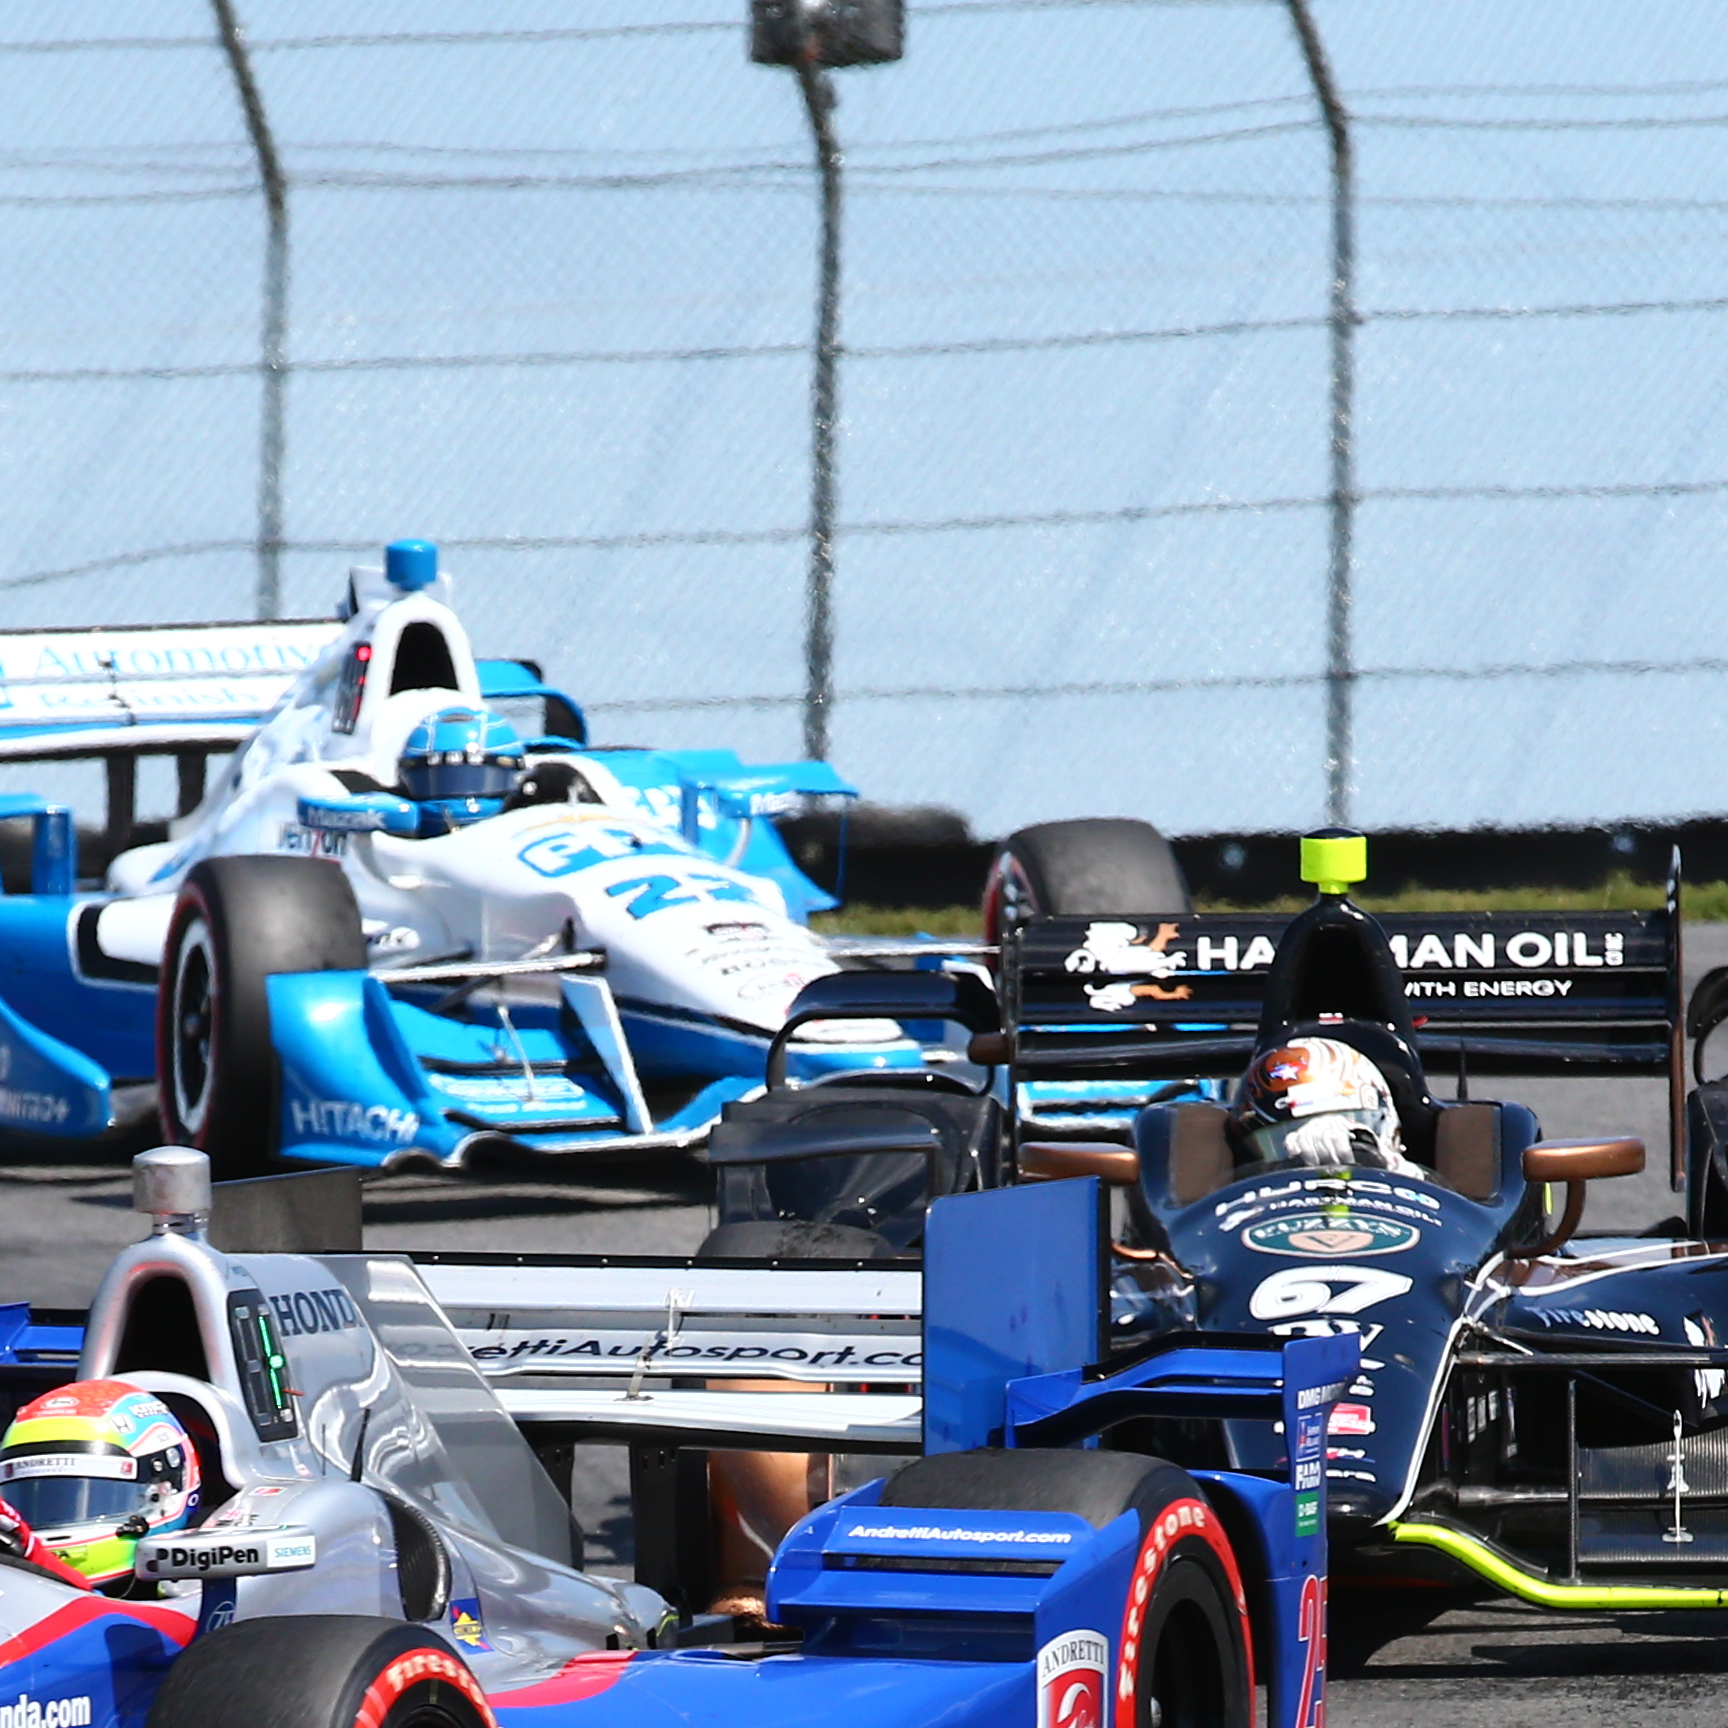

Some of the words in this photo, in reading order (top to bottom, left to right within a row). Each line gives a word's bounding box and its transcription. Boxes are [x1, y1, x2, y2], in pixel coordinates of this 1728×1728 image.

[36, 638, 320, 676] Automotiv
[1505, 932, 1603, 967] OIL
[1463, 979, 1572, 998] ENERGY
[291, 1100, 420, 1143] HITACHI
[1215, 1178, 1441, 1217] HURCO
[1249, 1265, 1414, 1320] 67
[269, 1288, 359, 1336] HOND
[1524, 1306, 1660, 1335] Firestone
[470, 1339, 922, 1365] ettiAutosport.co
[848, 1525, 1072, 1544] AndrettiAutosport.com
[172, 1546, 259, 1571] DigiPen
[274, 1545, 312, 1558] SIEMENS
[1119, 1505, 1206, 1701] Firestone
[1042, 1641, 1105, 1677] ANDRETTI
